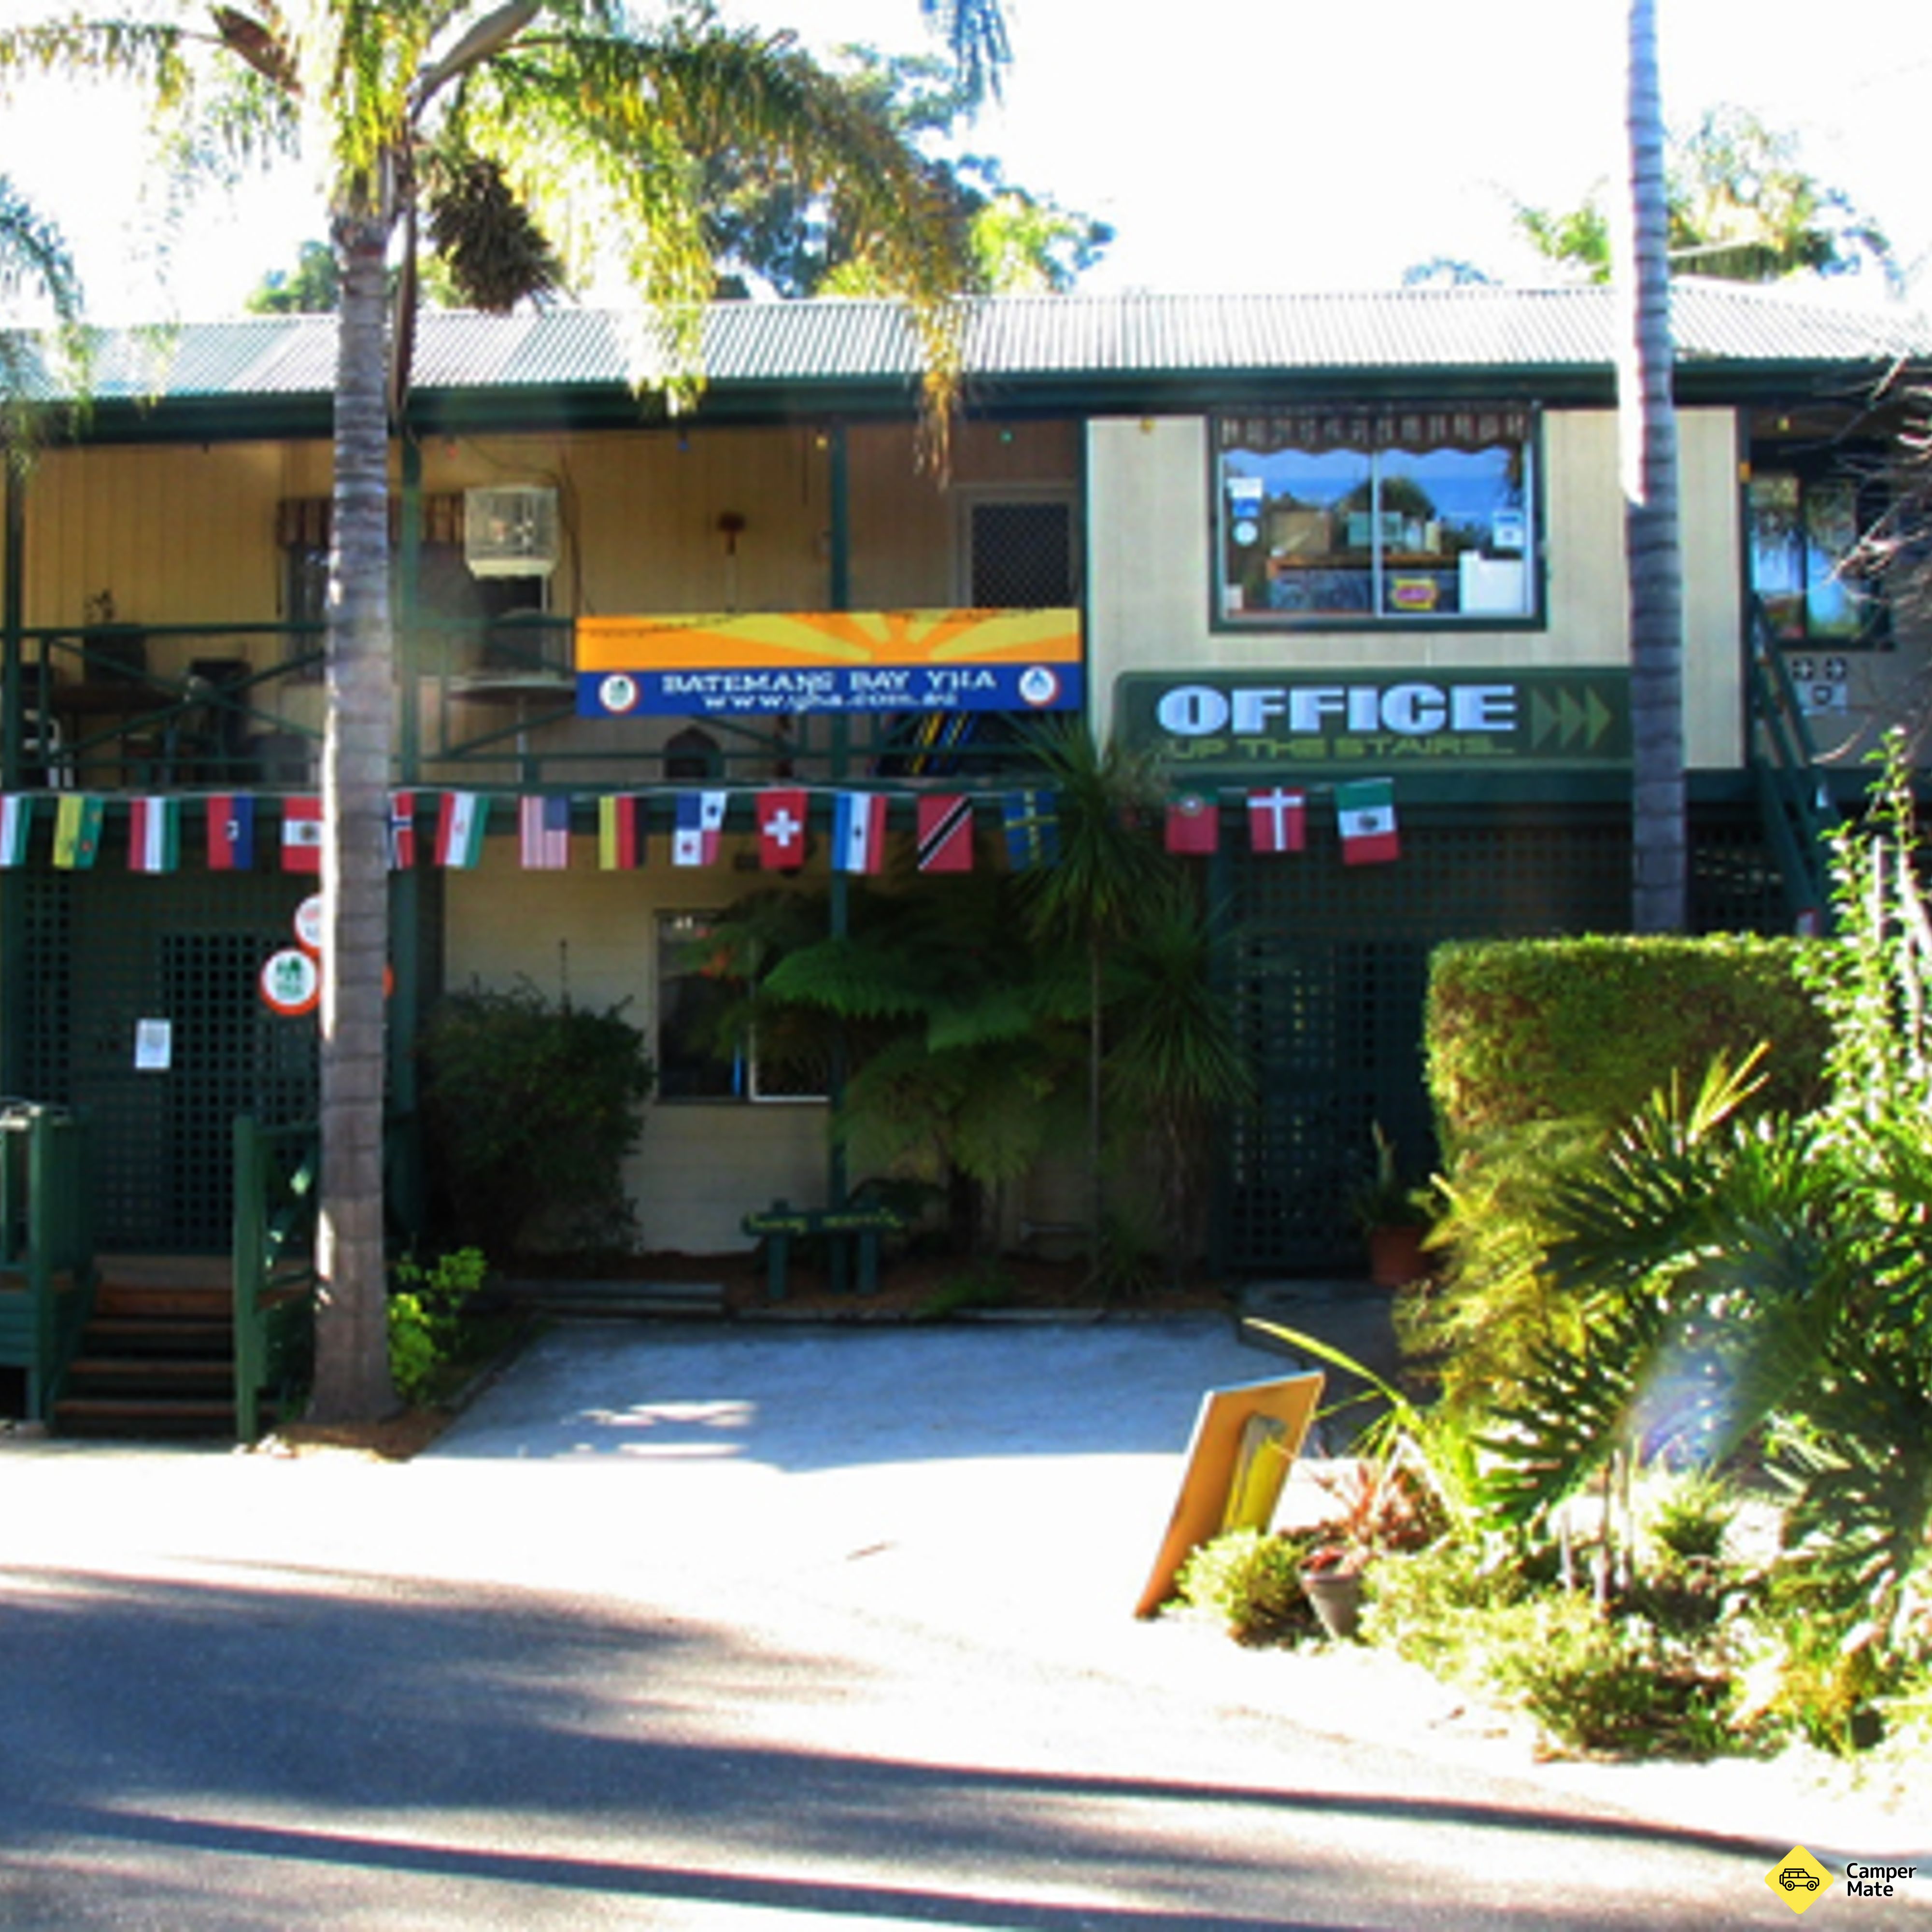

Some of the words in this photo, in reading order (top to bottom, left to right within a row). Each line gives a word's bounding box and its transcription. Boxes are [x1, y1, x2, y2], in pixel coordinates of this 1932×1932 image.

[850, 670, 910, 691] BAY
[926, 669, 997, 689] YHA
[1157, 682, 1517, 736] OFFICE
[1236, 737, 1325, 760] THE
